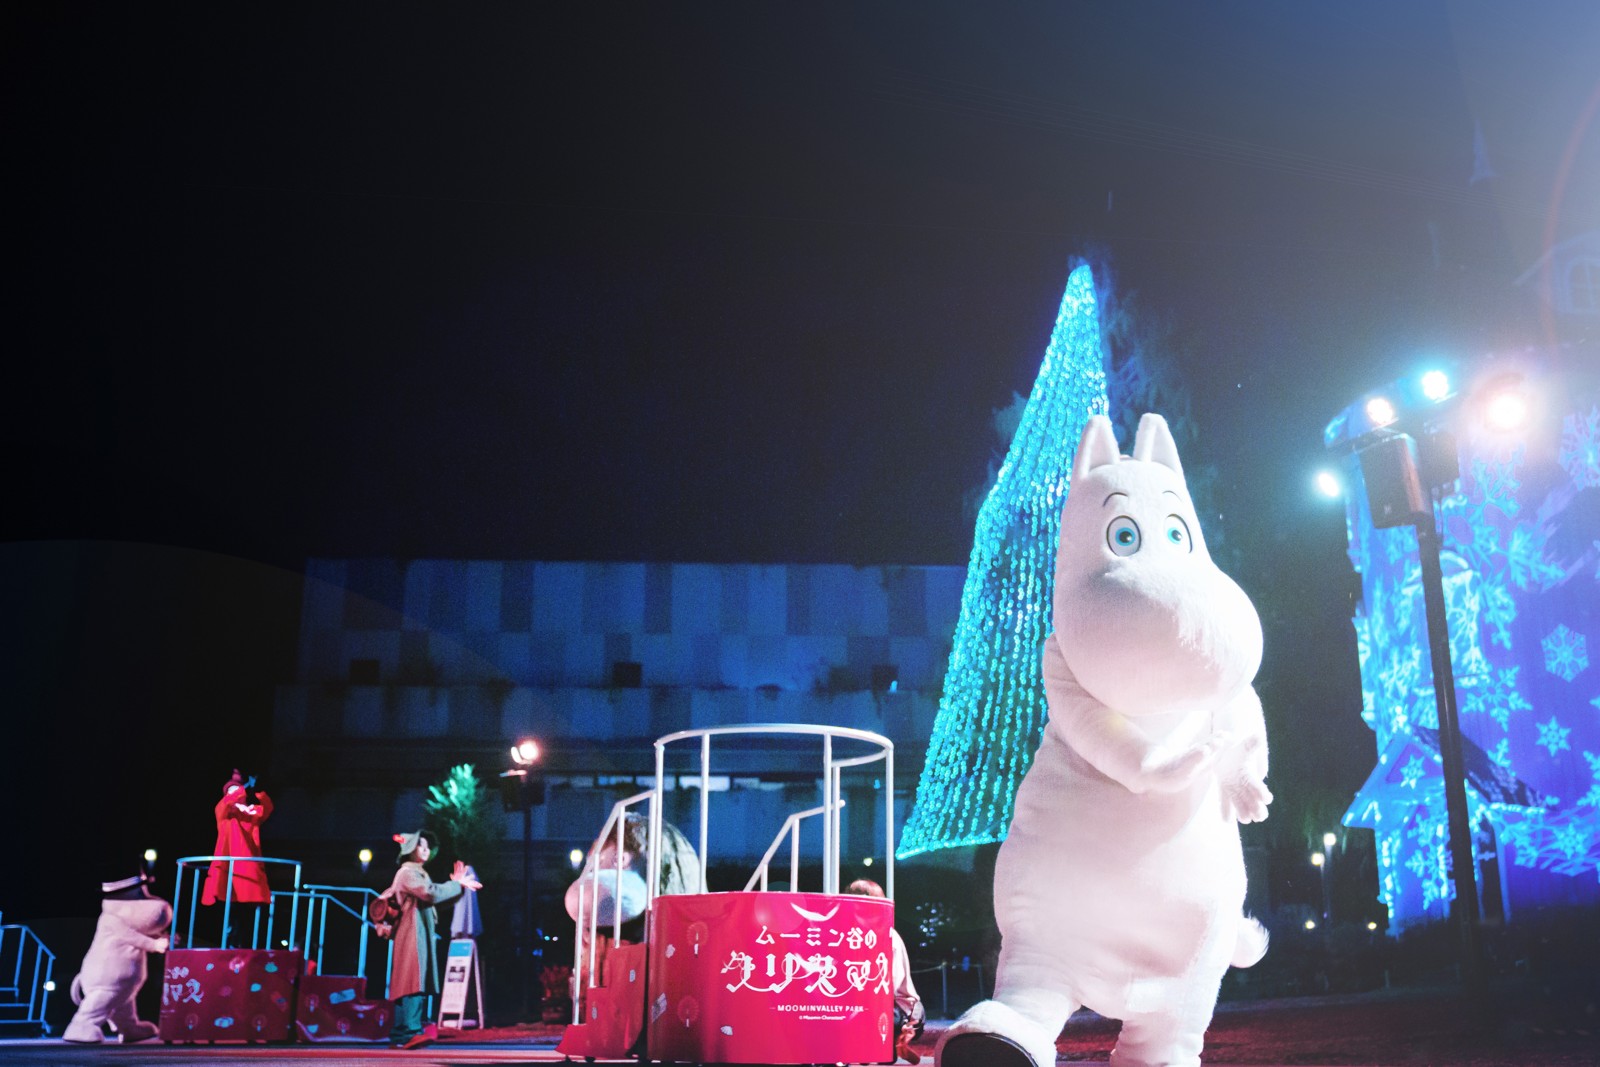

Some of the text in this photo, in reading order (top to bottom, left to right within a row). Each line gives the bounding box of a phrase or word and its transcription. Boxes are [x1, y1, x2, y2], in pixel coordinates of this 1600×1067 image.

[756, 926, 877, 949] ムーミン谷の
[720, 951, 890, 997] クリスマス
[777, 1004, 843, 1012] MOOMINVALLEY
